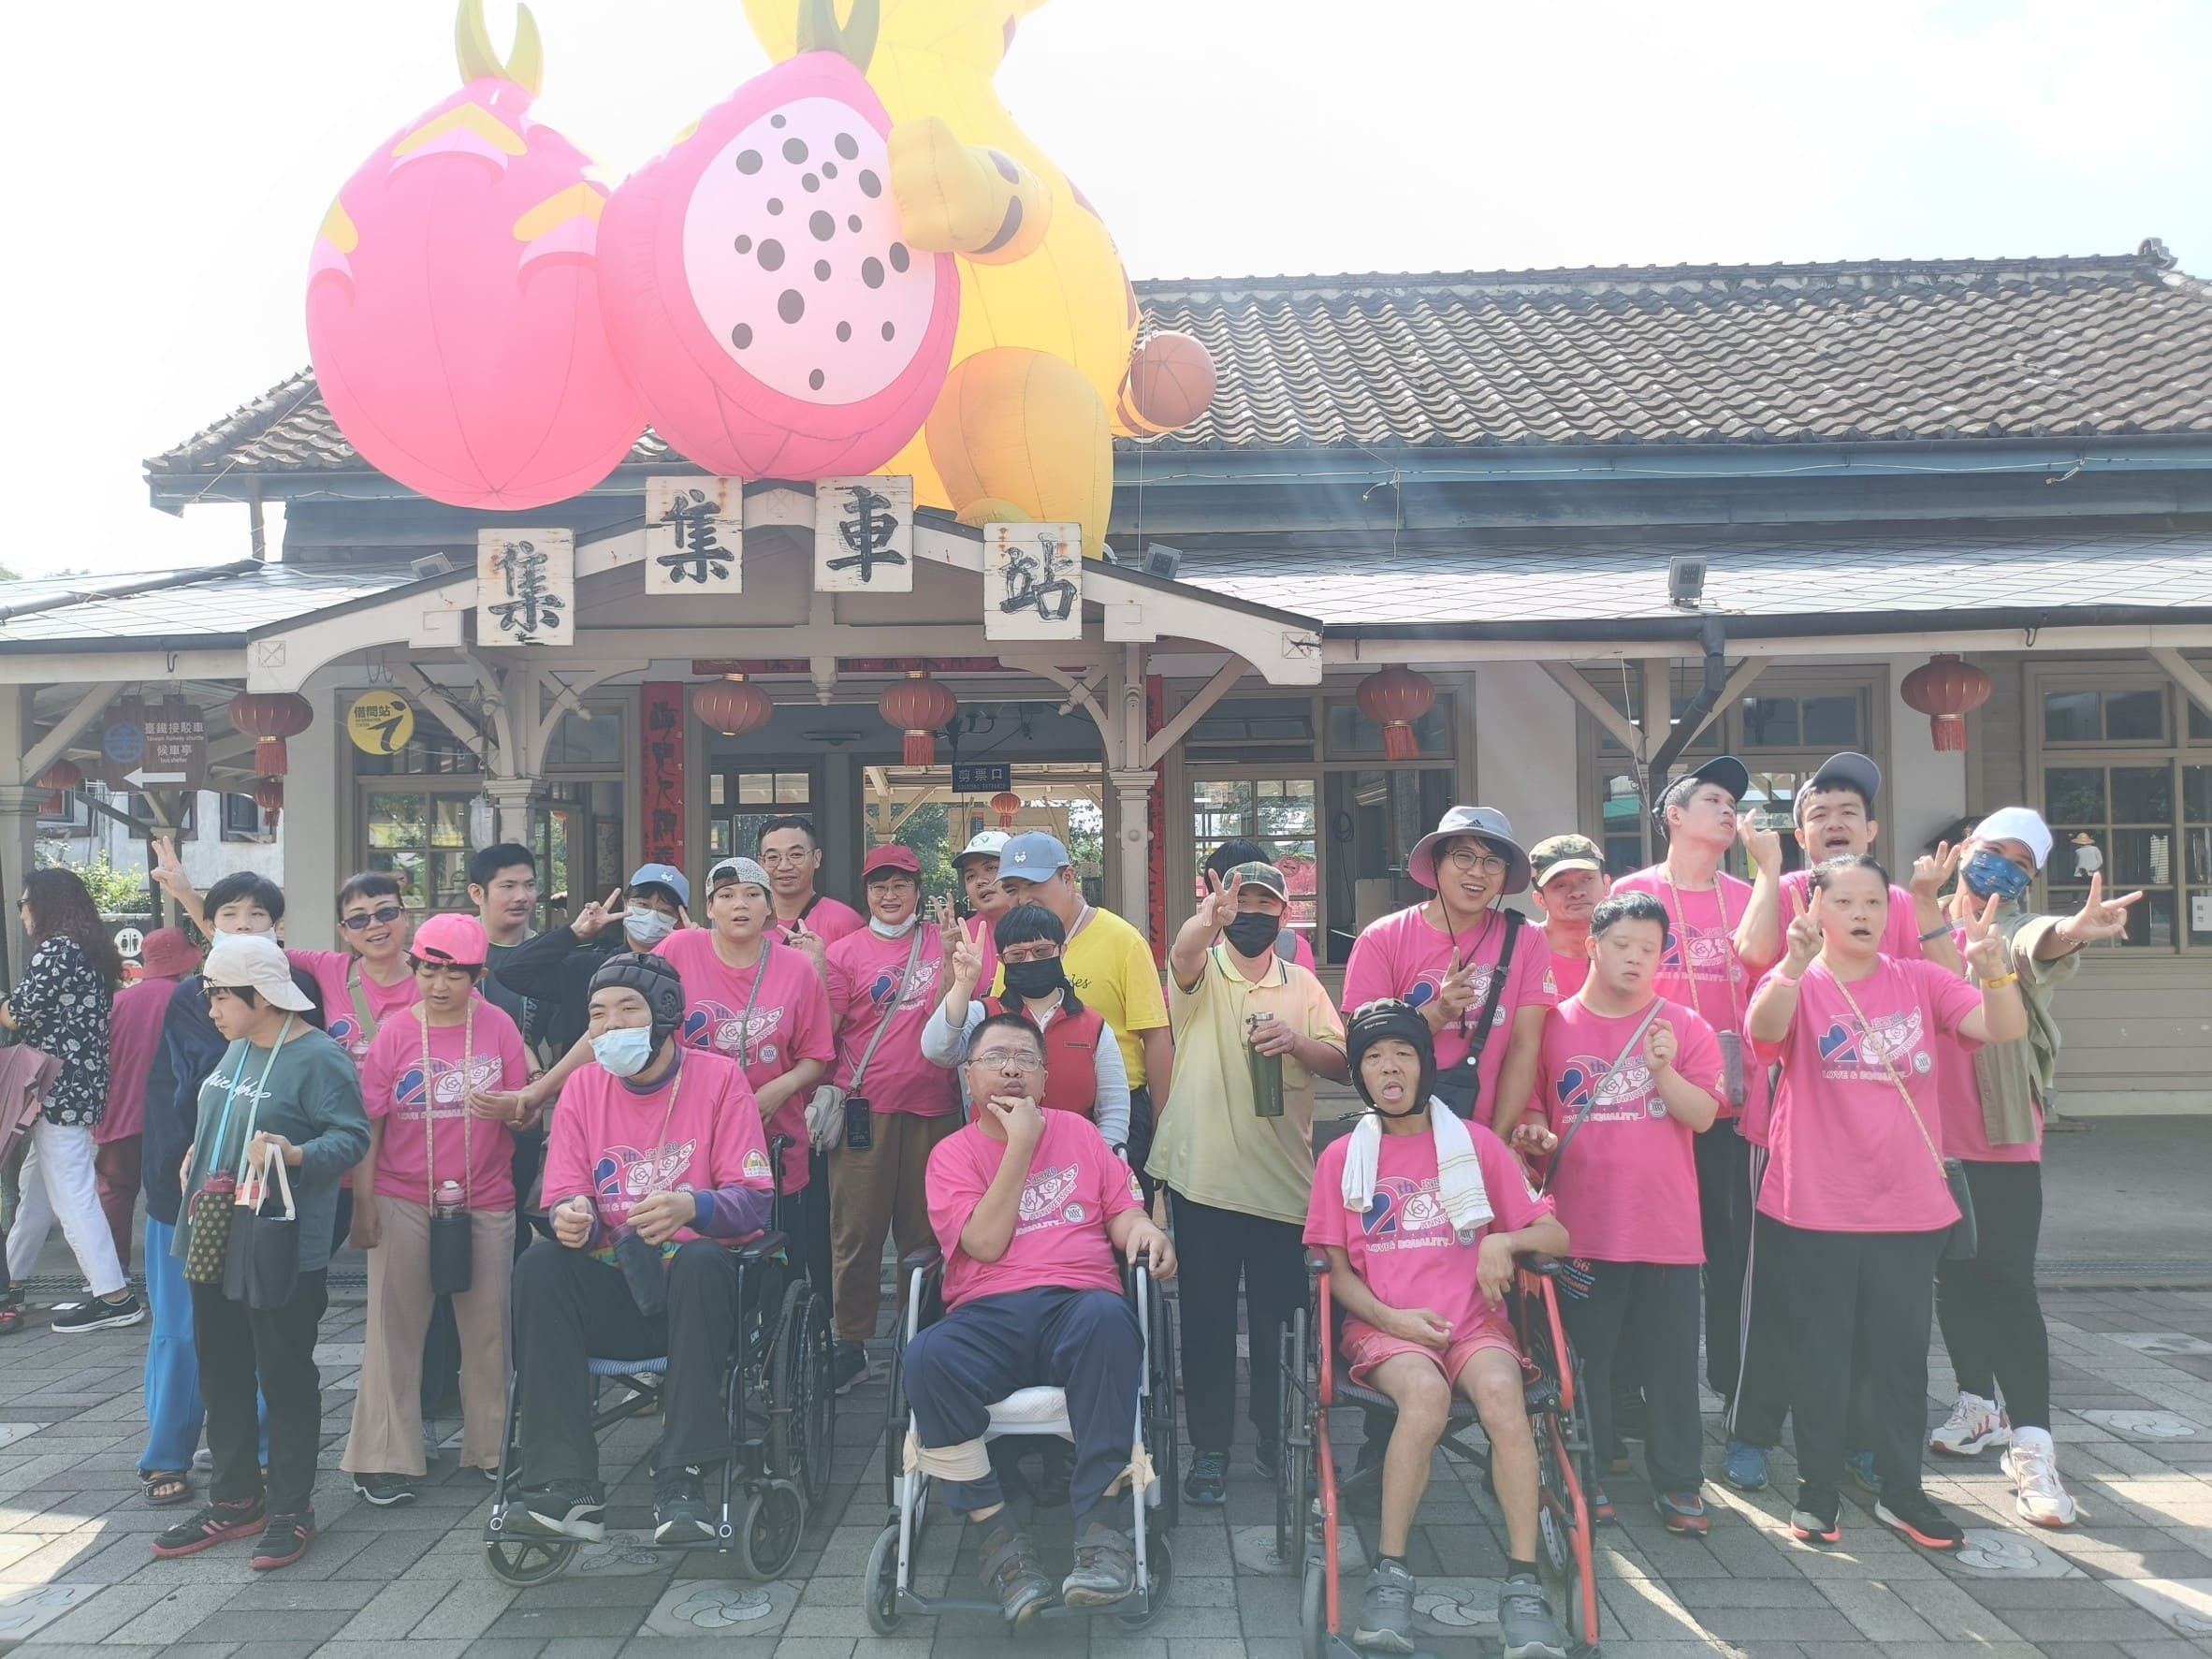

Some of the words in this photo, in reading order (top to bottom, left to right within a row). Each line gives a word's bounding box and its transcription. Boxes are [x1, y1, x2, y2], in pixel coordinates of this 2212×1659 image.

[488, 486, 1078, 623] 集集車站
[355, 705, 390, 718] 借問站
[157, 745, 192, 756] 候車亭
[958, 768, 1002, 783] 剪票口
[1822, 1070, 1848, 1080] LOVE
[1397, 1237, 1449, 1250] EQUALITY
